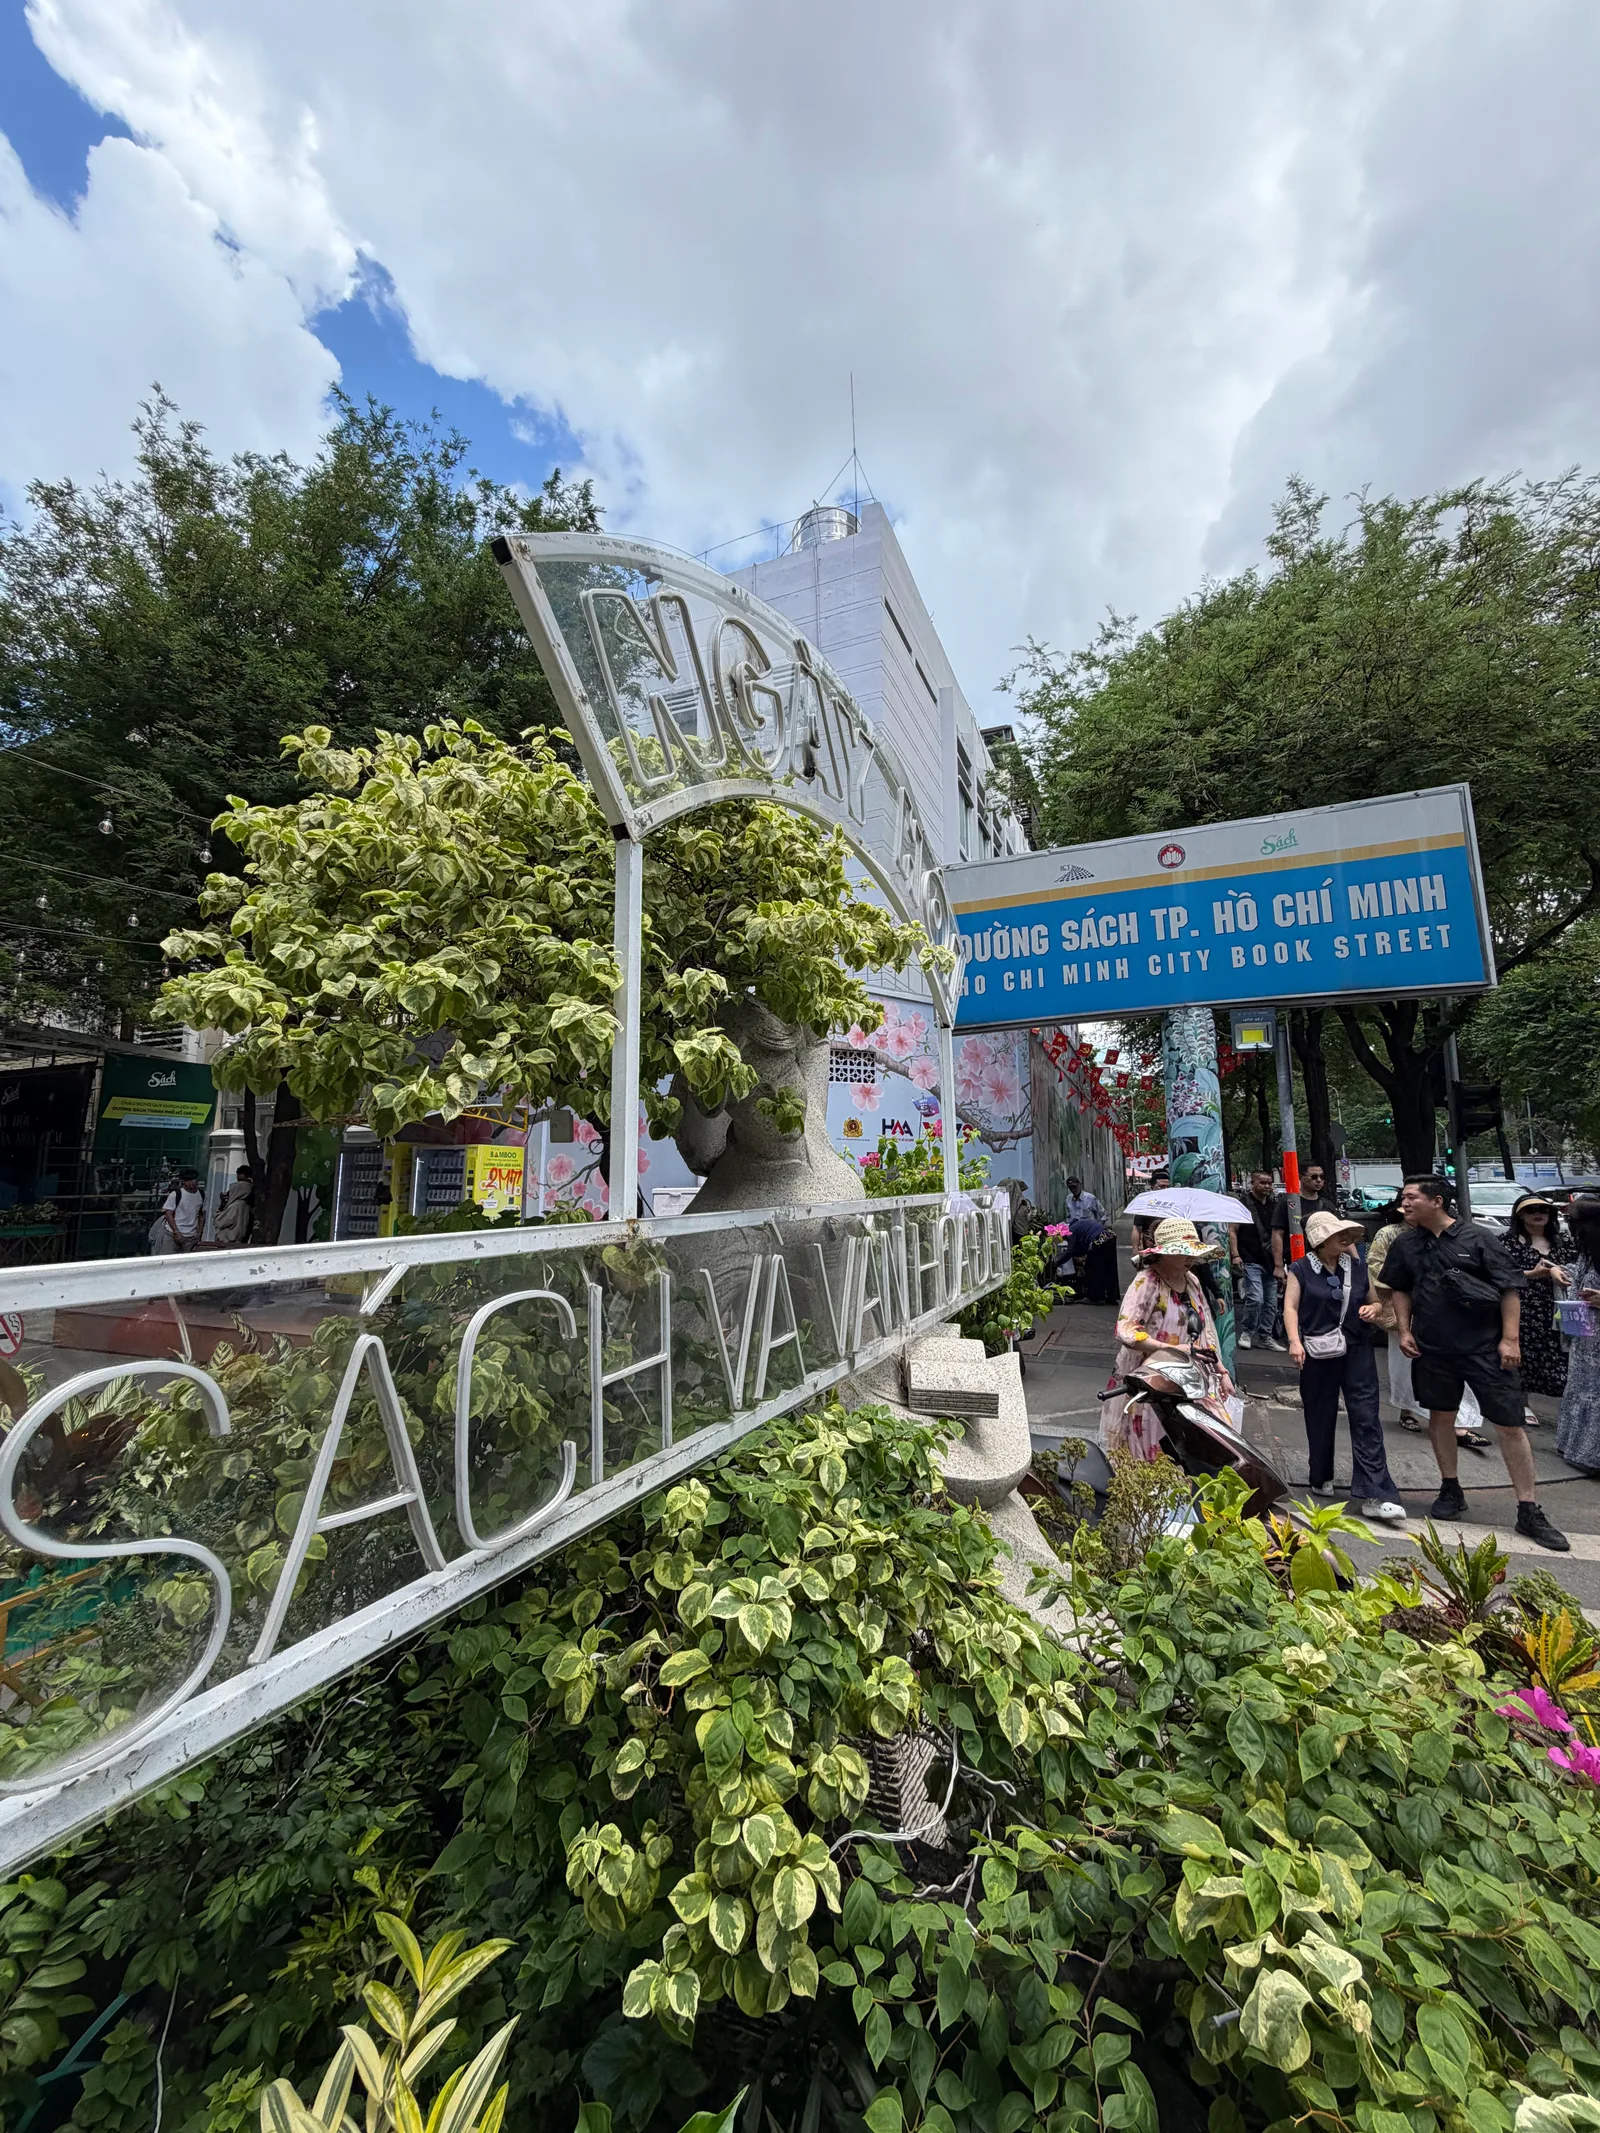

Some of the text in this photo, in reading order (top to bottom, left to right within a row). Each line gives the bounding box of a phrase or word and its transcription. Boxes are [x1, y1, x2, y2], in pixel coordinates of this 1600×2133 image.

[1260, 828, 1298, 855] Sách
[1061, 907, 1139, 952] SÁCH
[1151, 905, 1200, 942] TP.
[1212, 889, 1258, 935] HỒ
[1272, 877, 1334, 929] CHÍ
[1348, 874, 1448, 921] MINH
[1003, 967, 1045, 992] CHI
[1062, 957, 1130, 986] MINH
[1149, 949, 1211, 977] CITY
[1231, 939, 1314, 969] BOOK
[1334, 924, 1452, 960] STREET
[147, 1070, 177, 1088] Sách
[490, 1150, 517, 1159] BAMBOO
[0, 1260, 673, 1797] SÁCH
[699, 1219, 807, 1411] VÀ
